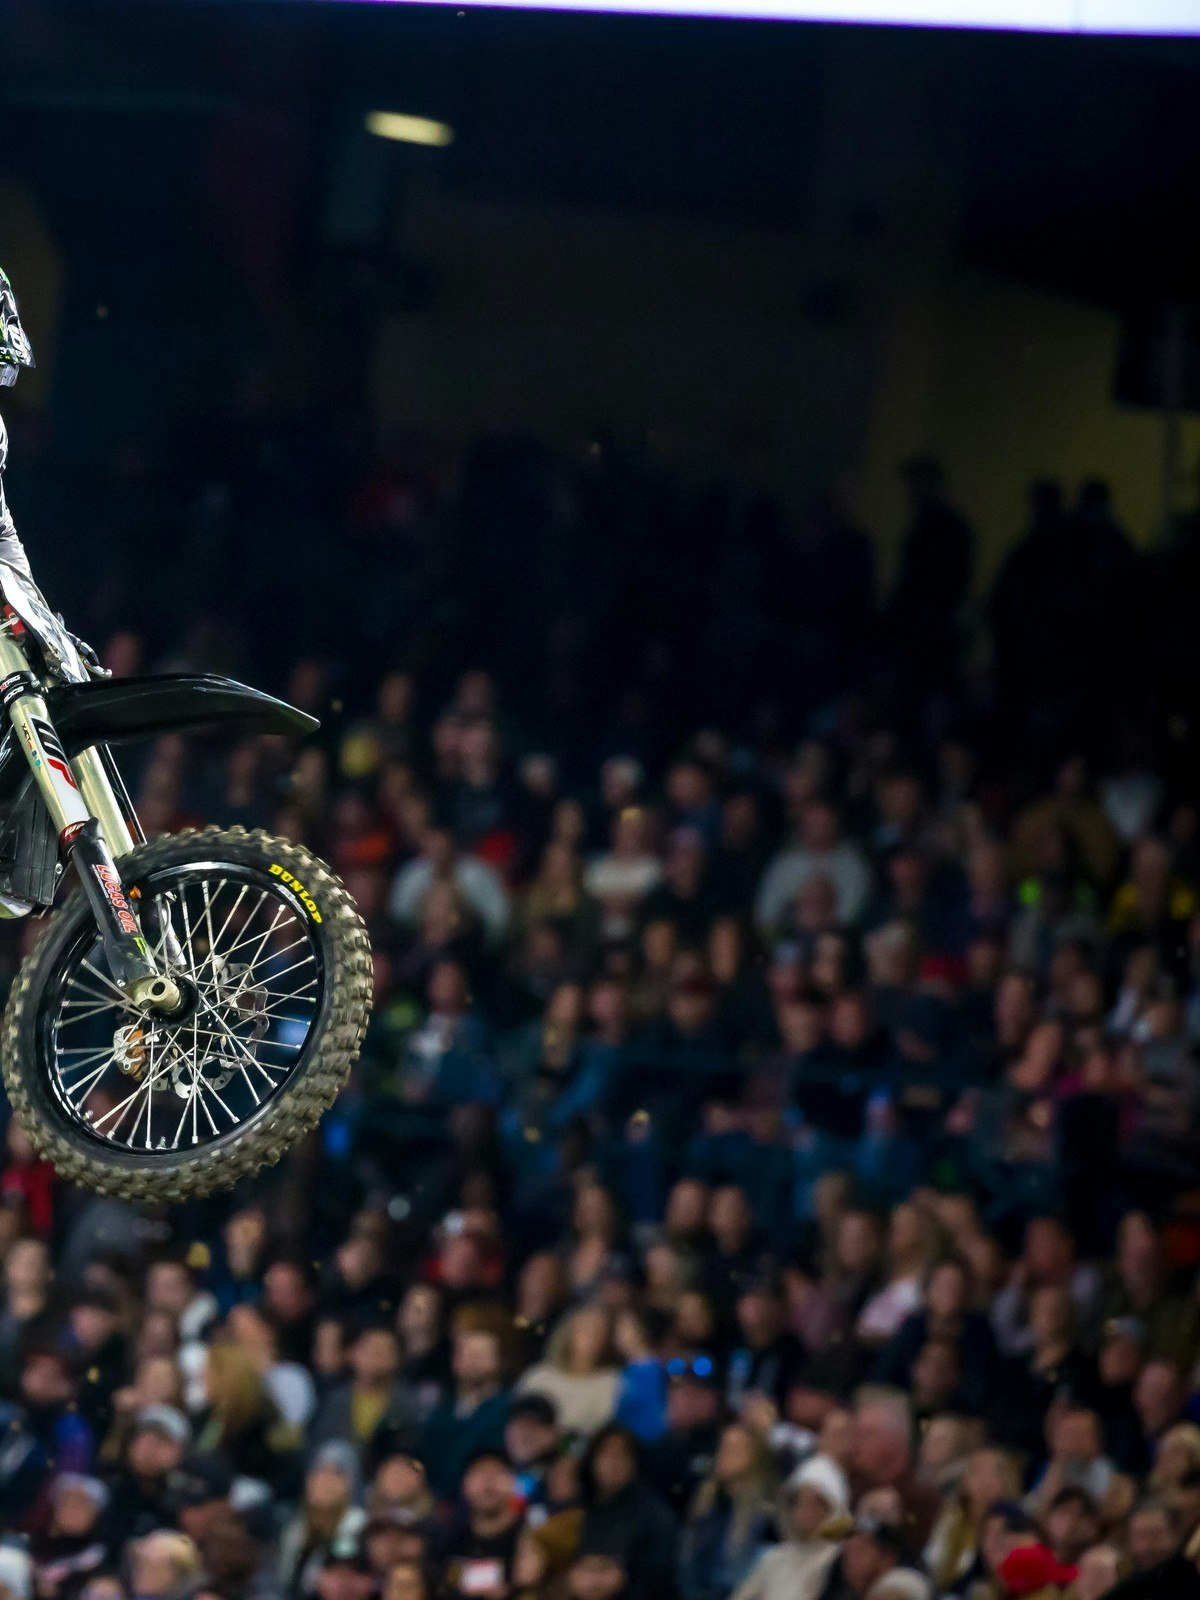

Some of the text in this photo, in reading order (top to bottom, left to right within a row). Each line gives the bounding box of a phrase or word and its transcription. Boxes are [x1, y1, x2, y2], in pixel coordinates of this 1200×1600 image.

[96, 864, 129, 911] LUCAS
[117, 909, 139, 933] OIL
[268, 863, 323, 924] DUNLOP
